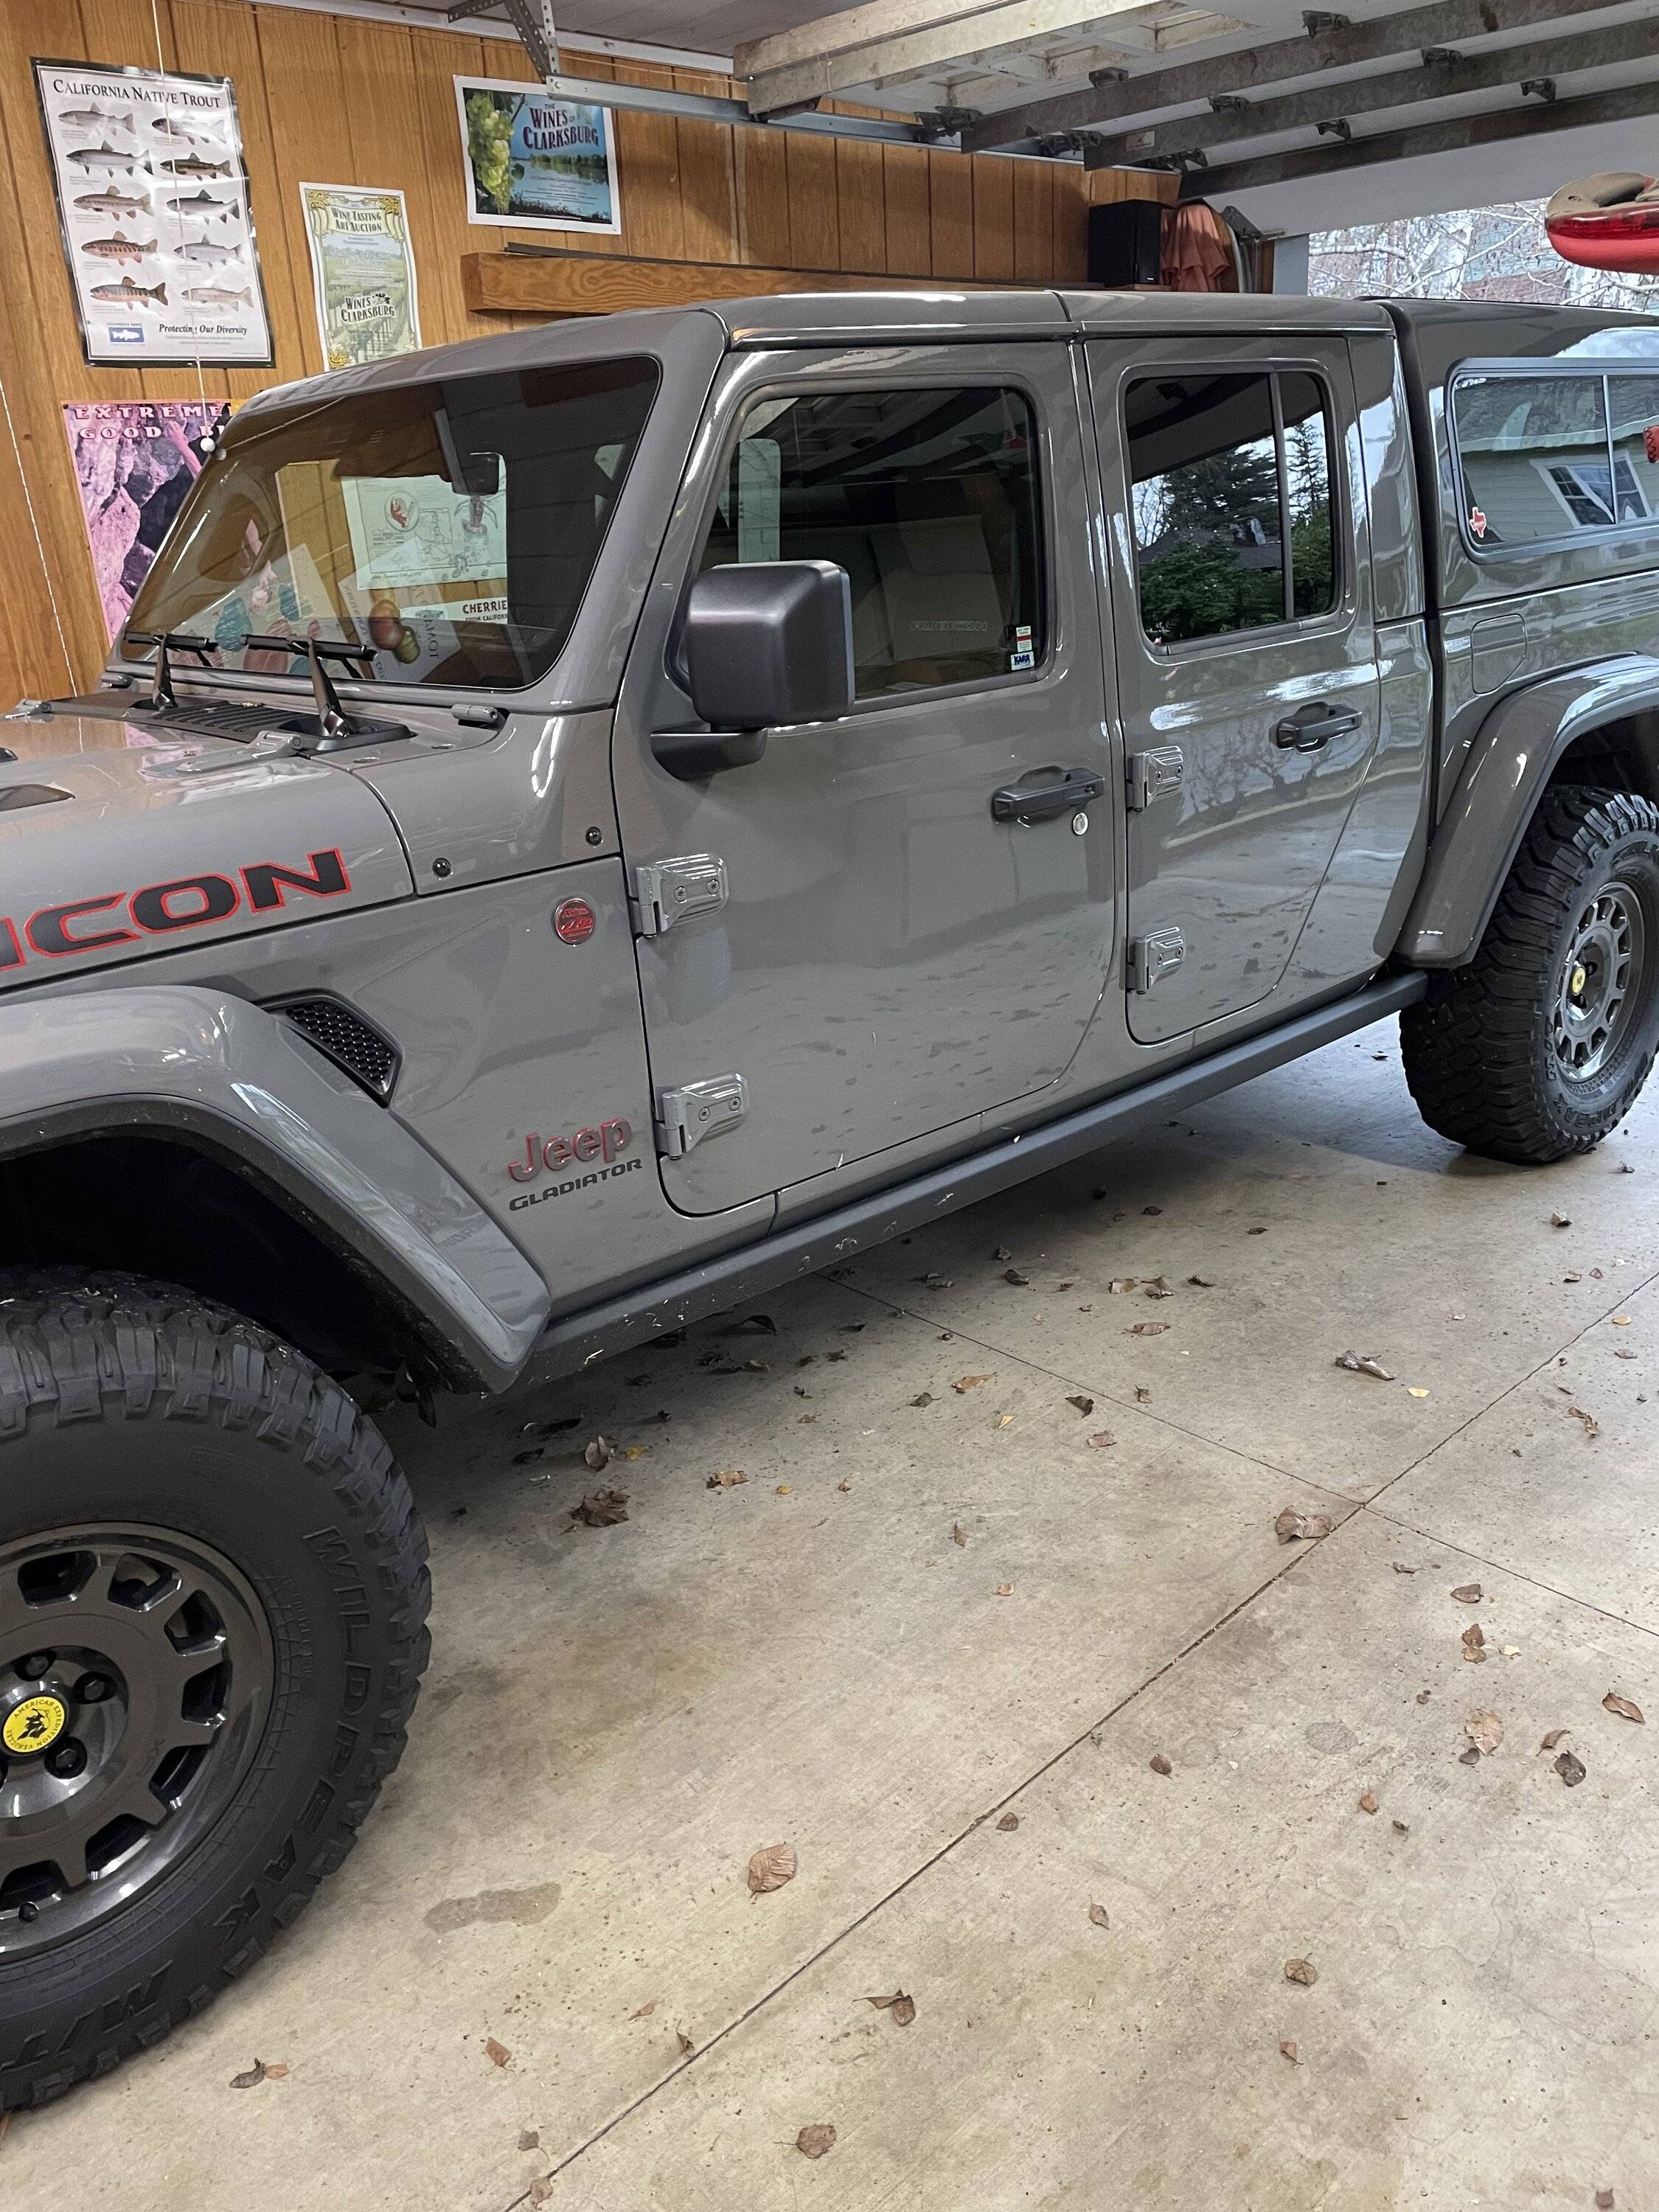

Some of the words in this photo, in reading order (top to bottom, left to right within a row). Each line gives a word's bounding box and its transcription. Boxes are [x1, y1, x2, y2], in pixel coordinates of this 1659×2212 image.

[53, 79, 131, 100] CALIFORNIA
[179, 91, 220, 108] TROUT
[529, 108, 568, 129] WINES
[523, 126, 599, 150] CLARKSBURG
[341, 305, 395, 322] CLARKSBURG
[345, 297, 371, 310] WINES
[199, 325, 214, 333] Our
[217, 325, 247, 335] Diversity
[79, 426, 162, 439] GOOD
[507, 1118, 632, 1182] Jeep
[509, 1158, 642, 1211] GLADIATOR
[14, 1699, 55, 1718] AMERICAN
